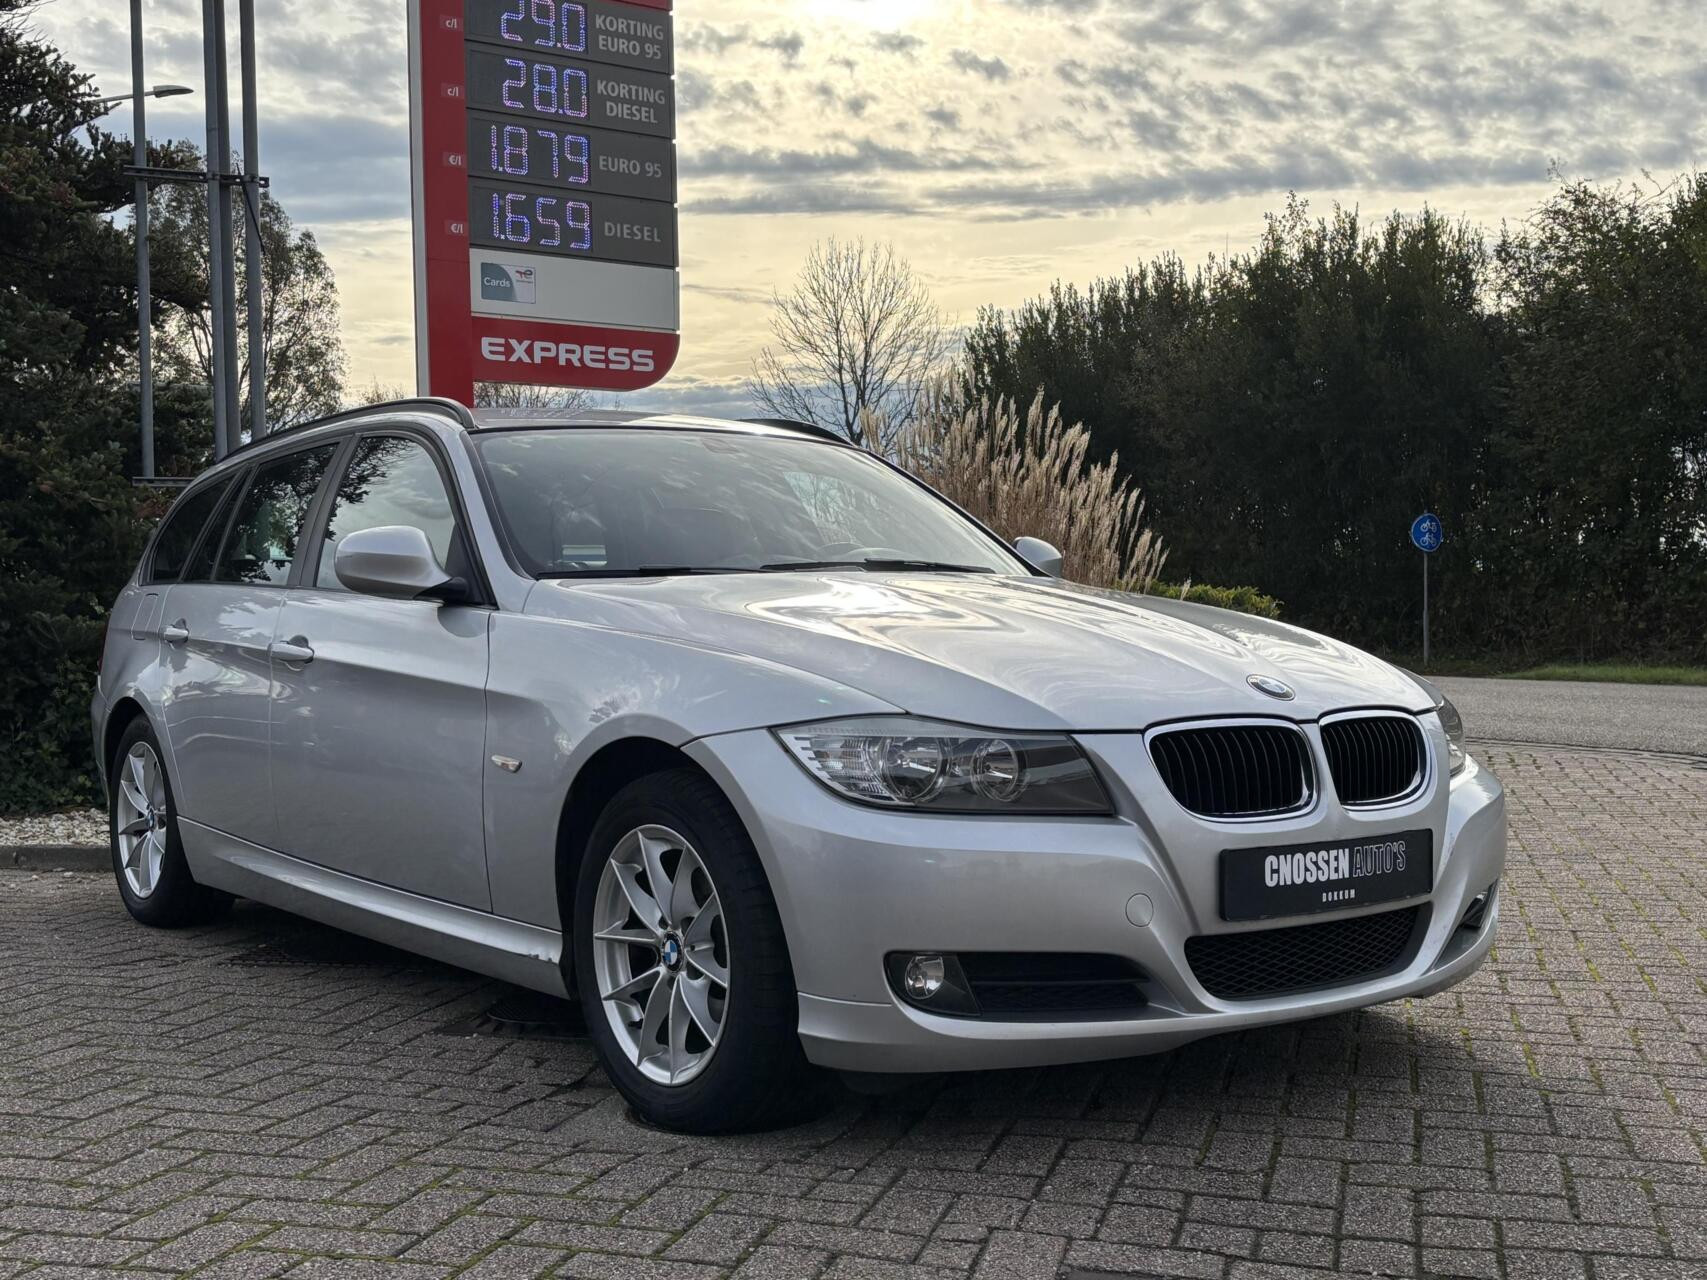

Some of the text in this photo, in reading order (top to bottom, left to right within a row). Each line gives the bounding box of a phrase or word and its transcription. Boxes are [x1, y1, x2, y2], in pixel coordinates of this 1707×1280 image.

[500, 0, 586, 51] 29.0
[595, 14, 664, 40] KORTING
[598, 35, 662, 60] EURO 95
[502, 58, 588, 118] 28.0
[596, 79, 665, 105] KORTING
[605, 101, 658, 124] DIESEL
[490, 124, 589, 184] 1.879
[599, 156, 662, 178] EURO 95
[492, 193, 591, 250] 1.659
[604, 222, 661, 243] DIESEL
[483, 277, 511, 288] Cards
[481, 337, 655, 372] EXPRESS
[1264, 840, 1406, 888] CNOSSEN AUTO'S
